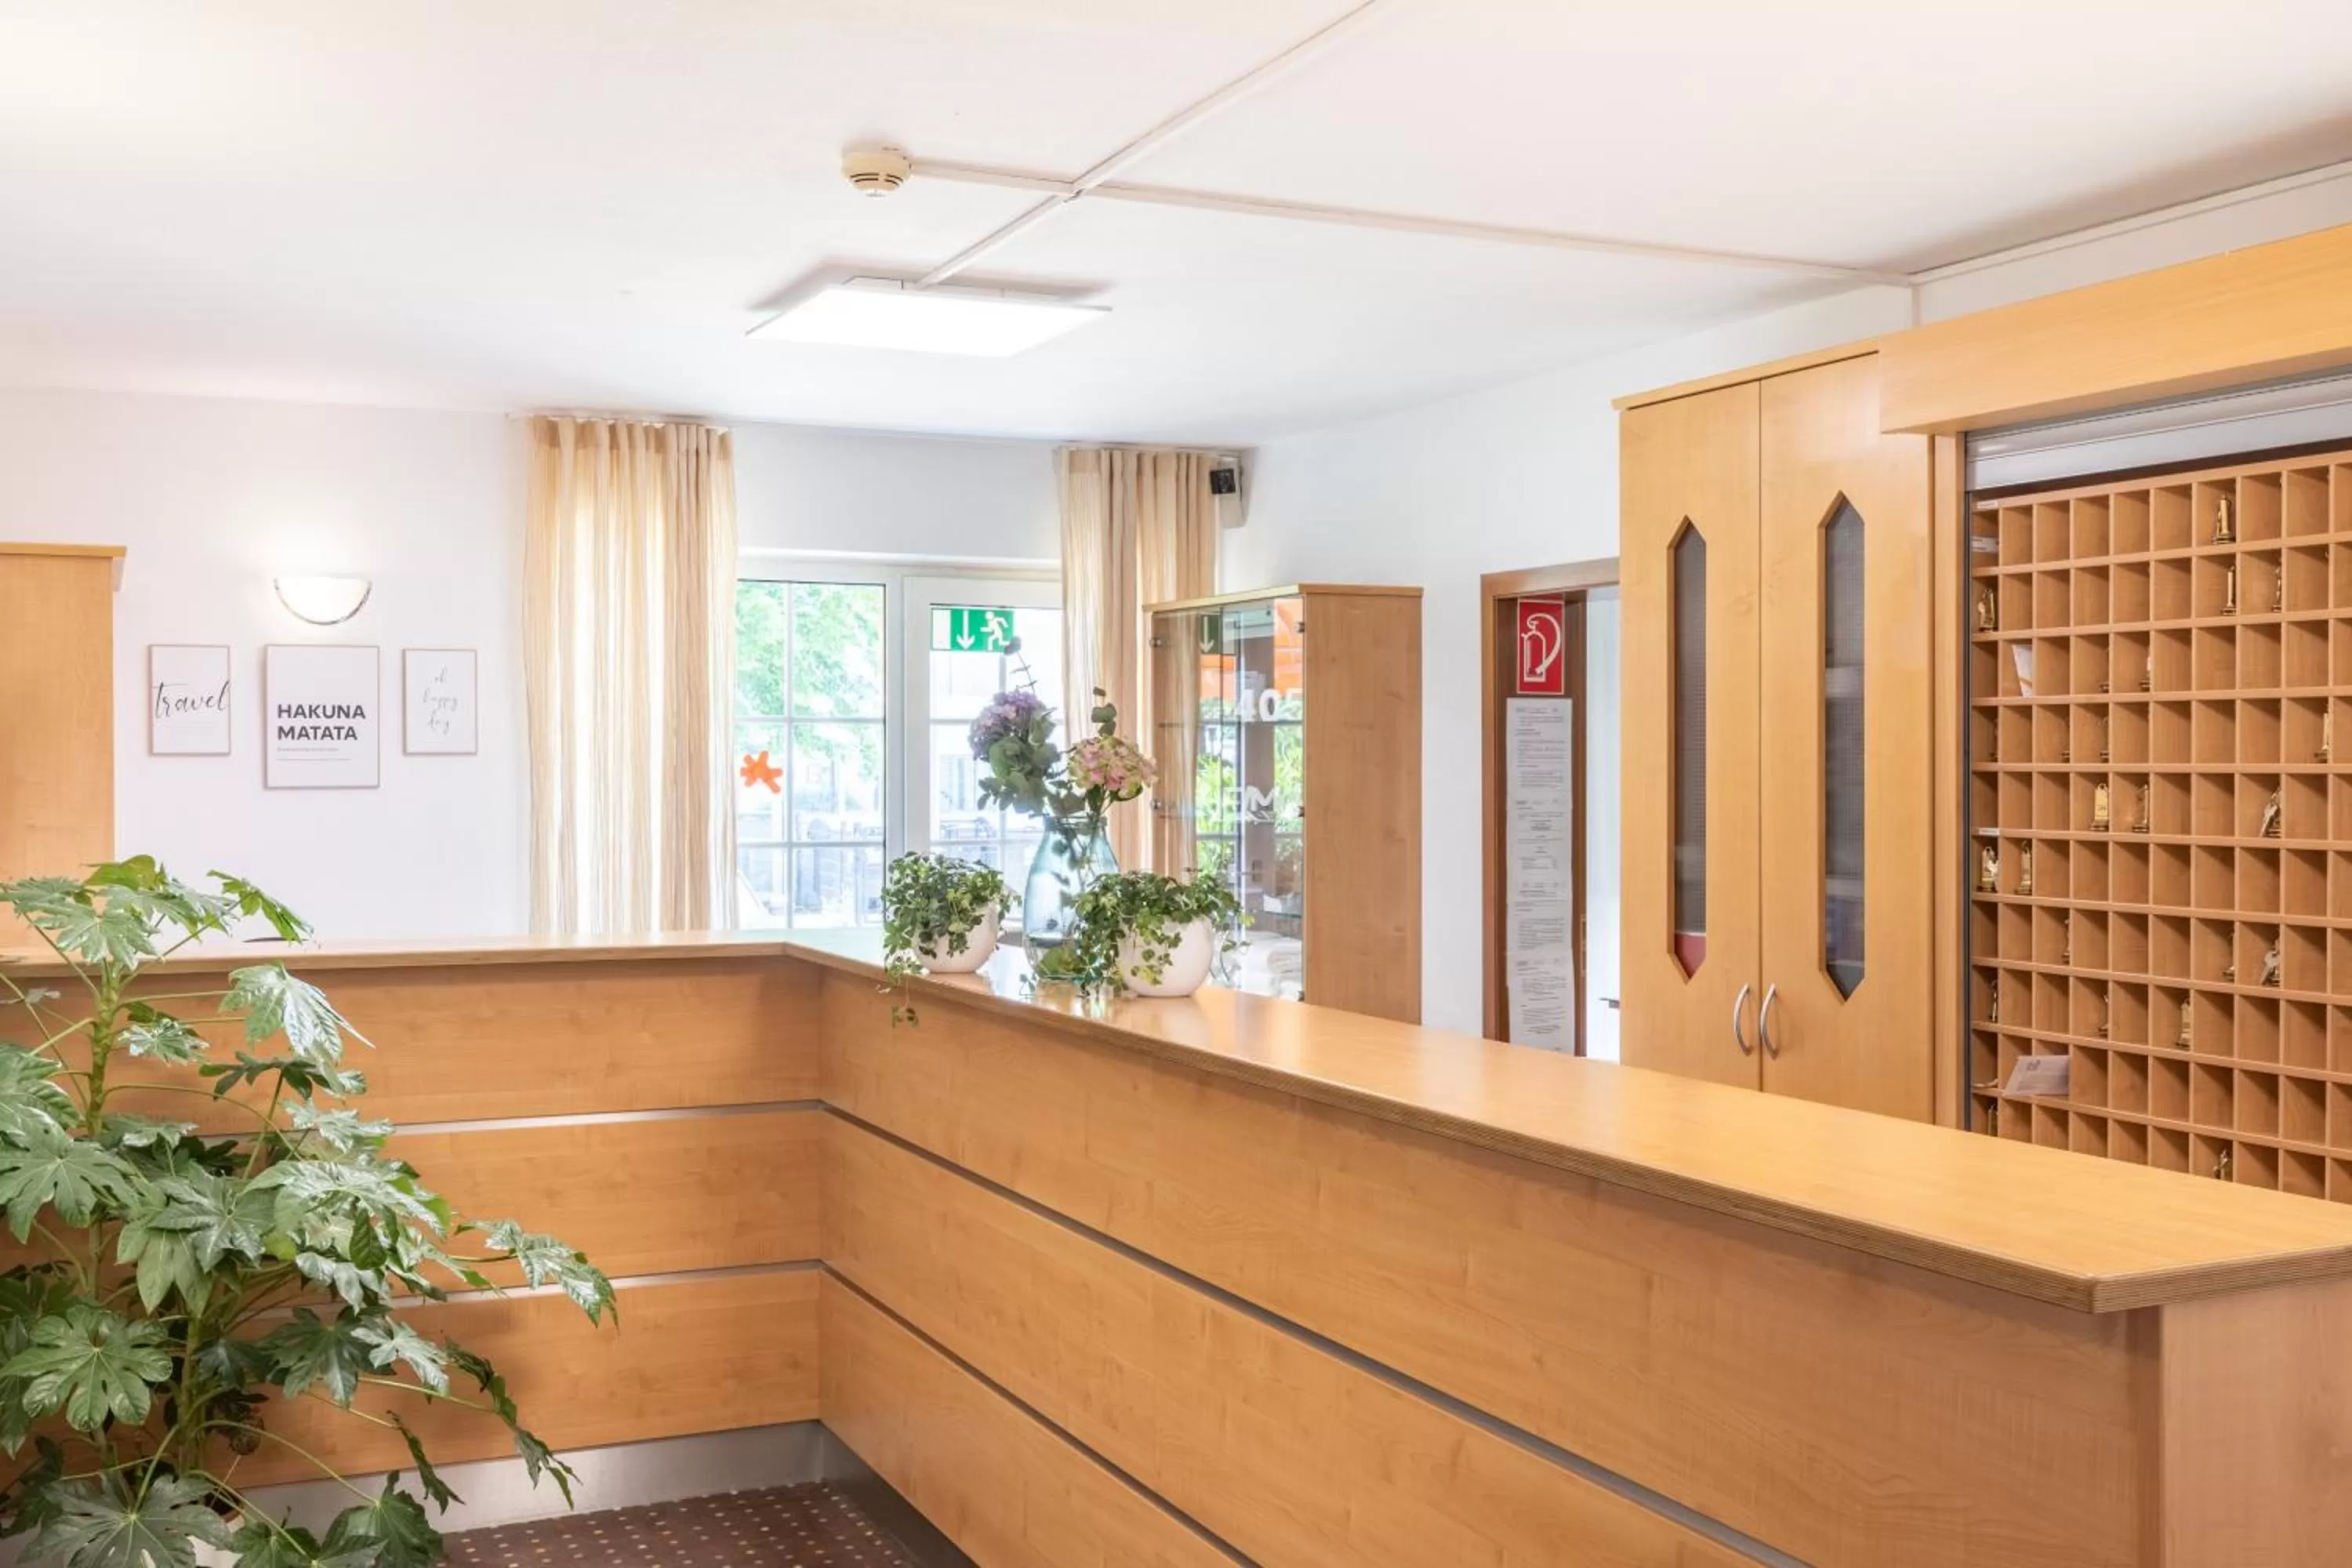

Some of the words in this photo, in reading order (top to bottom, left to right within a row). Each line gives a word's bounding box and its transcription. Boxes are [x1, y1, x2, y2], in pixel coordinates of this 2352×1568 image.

[150, 680, 230, 718] travel
[278, 704, 366, 719] HAKUNA
[278, 726, 358, 740] MATATA
